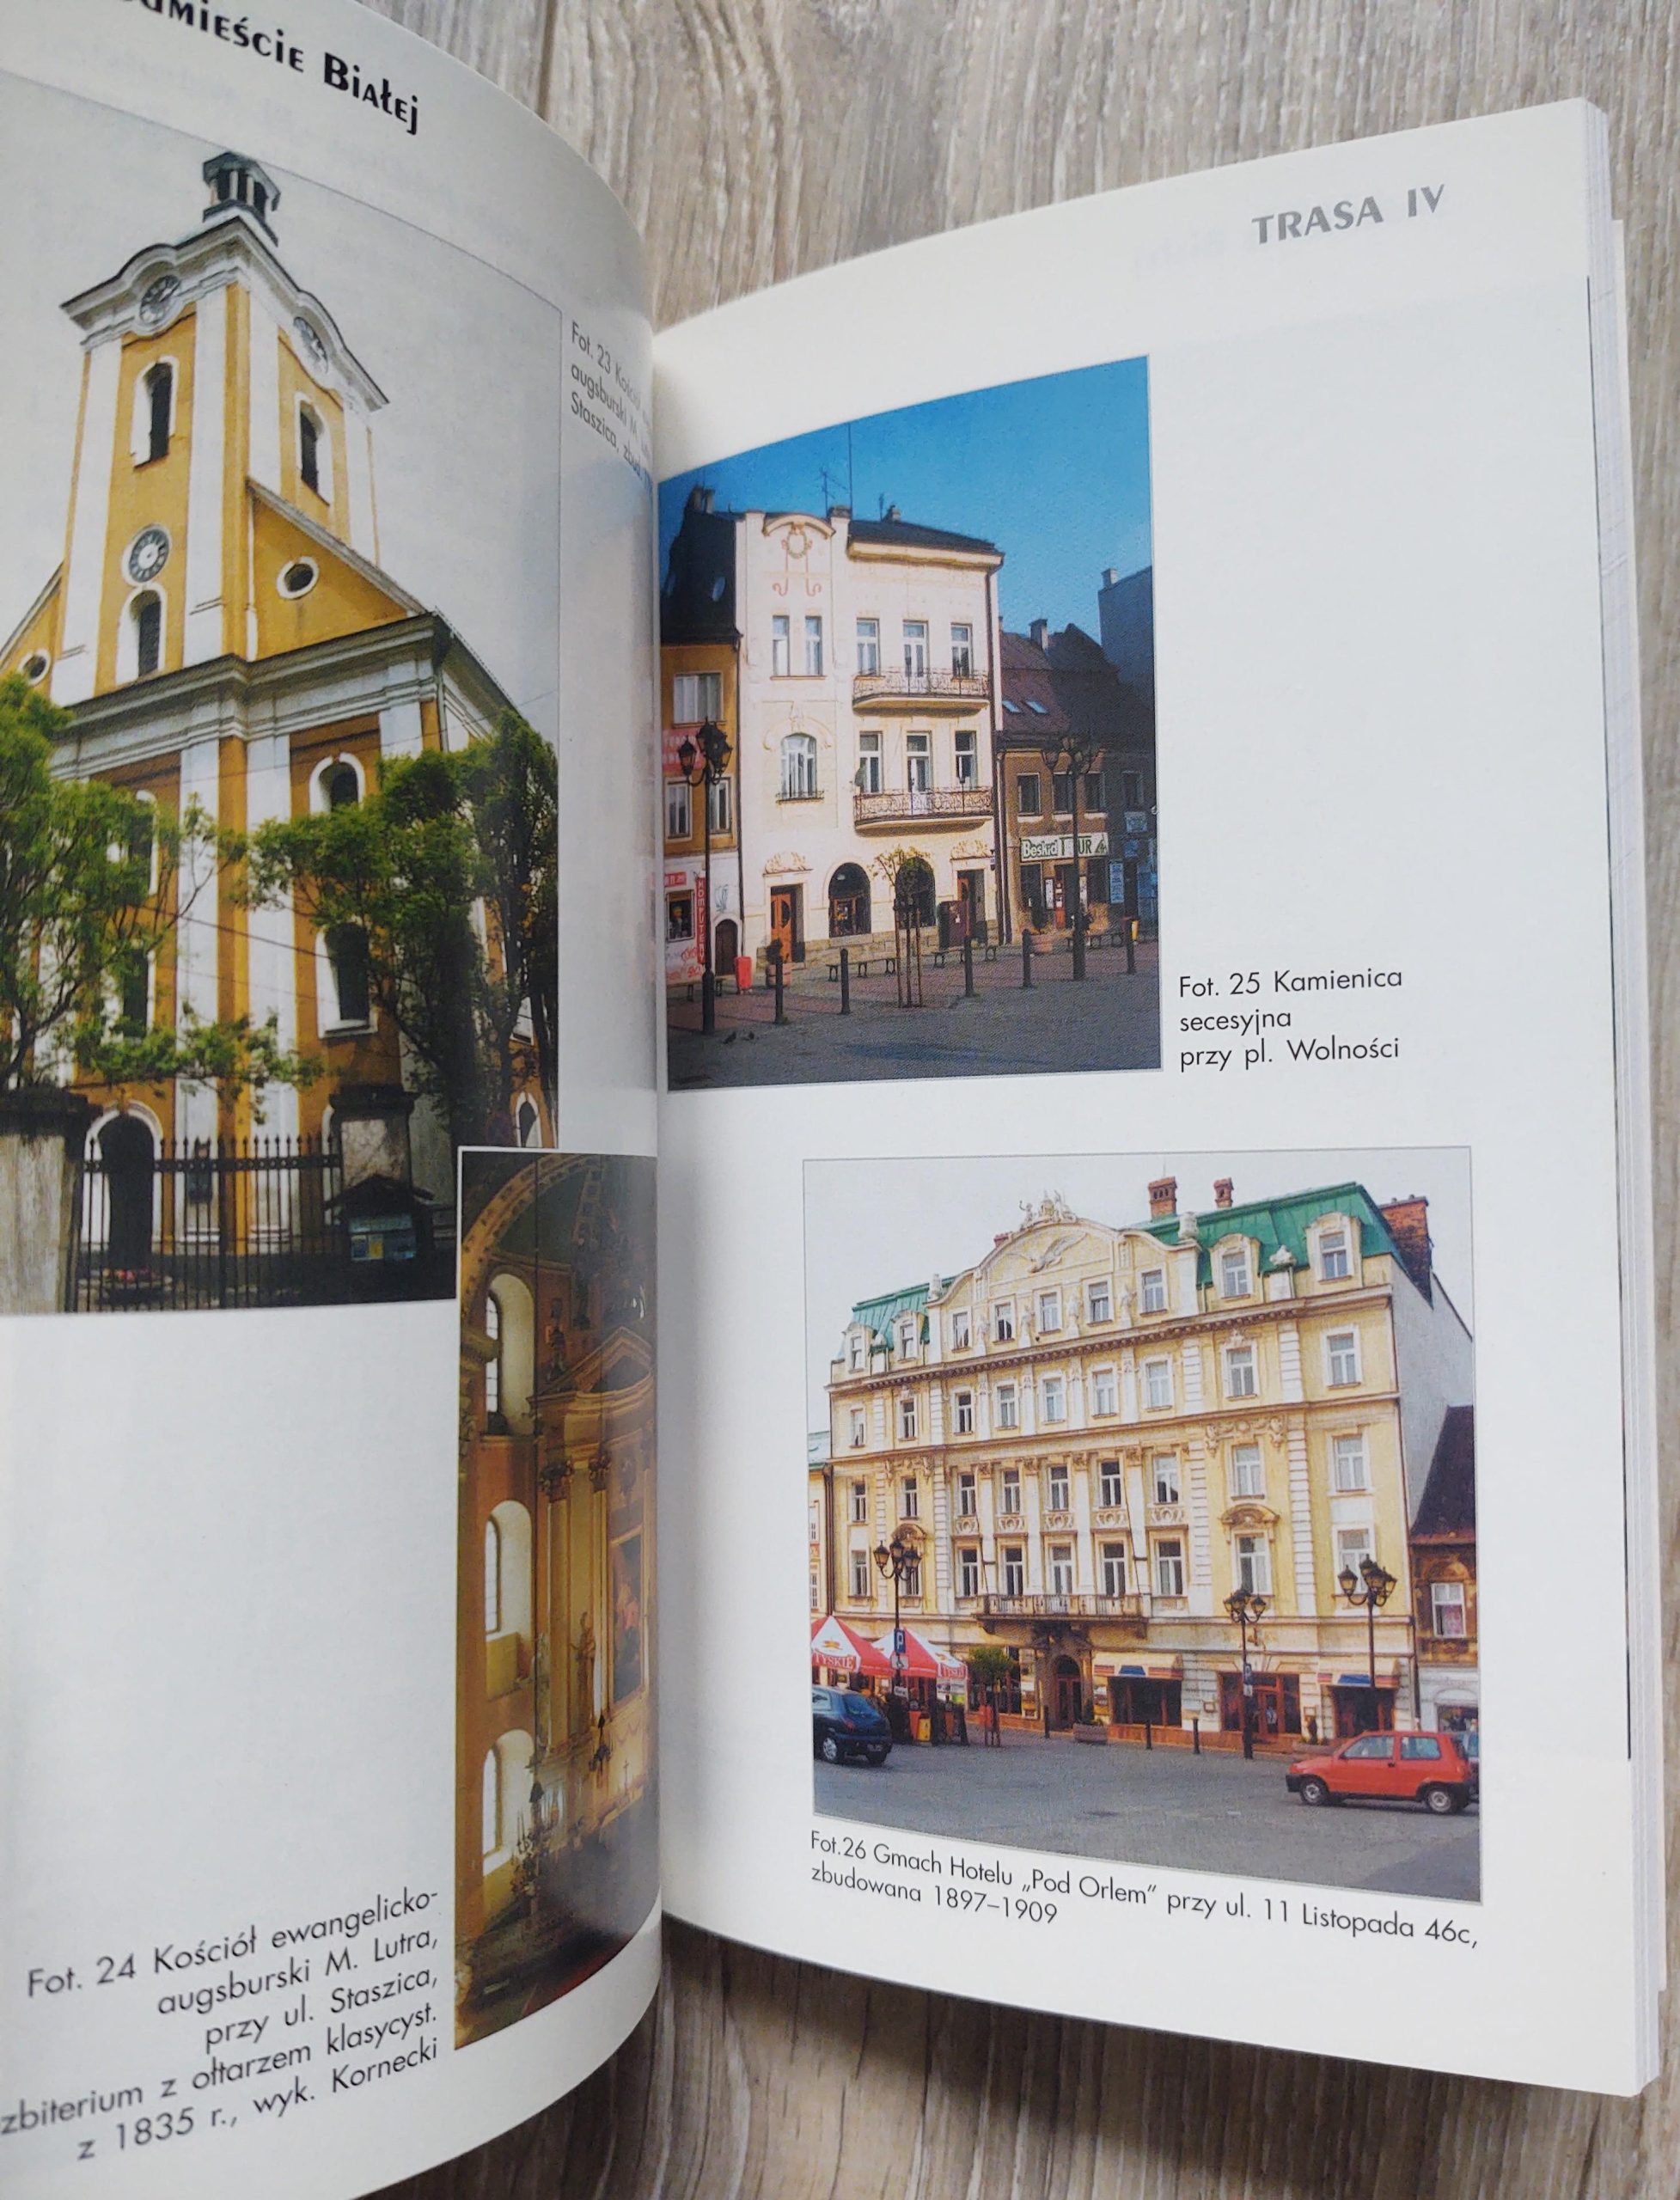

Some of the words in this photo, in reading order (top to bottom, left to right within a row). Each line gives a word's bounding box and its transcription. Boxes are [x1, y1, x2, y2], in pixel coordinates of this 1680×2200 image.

[1251, 196, 1384, 245] TRASA
[1408, 184, 1445, 217] IV
[571, 320, 593, 359] Fot.
[597, 343, 611, 375] 23
[571, 364, 626, 427] augsburski
[571, 391, 620, 453] Staszica,
[1022, 839, 1059, 859] Beskid
[1059, 835, 1093, 856] TUR
[1180, 975, 1219, 998] Fot.
[1229, 972, 1261, 995] 25
[1274, 968, 1402, 993] Kamienica
[1180, 1009, 1292, 1036] secesyjna
[1181, 1049, 1232, 1072] przy
[1245, 1037, 1273, 1070] pl.
[1286, 1034, 1400, 1061] Wolności
[815, 1651, 854, 1669] TYSKIE
[811, 1861, 921, 1902] zbudowana
[811, 1830, 866, 1859] Fot.26
[873, 1843, 942, 1874] Gmach
[950, 1856, 1013, 1885] Hotelu
[1022, 1868, 1070, 1893] „Pod
[1167, 1893, 1216, 1919] przy
[1226, 1892, 1251, 1917] ul.
[1264, 1898, 1288, 1922] 11
[1303, 1903, 1414, 1938] Listopada
[1425, 1919, 1478, 1949] 46c,
[27, 1967, 82, 1998] Fot.
[96, 1953, 136, 1986] 24
[154, 1924, 256, 1974] Kościół
[272, 1886, 437, 1949] ewangelicko-
[158, 1956, 309, 2014] augsburski
[325, 1946, 357, 1977] M.
[375, 1930, 437, 1962] Lutra,
[205, 2014, 269, 2055] przy
[284, 1994, 314, 2026] ul.
[330, 1969, 437, 2014] Staszica,
[0, 2086, 143, 2136] zbiterium
[161, 2078, 177, 2099] z
[192, 2044, 311, 2090] ołtarzem
[327, 2002, 436, 2055] klasycyst.
[77, 2139, 95, 2160] z
[117, 2106, 194, 2150] 1835
[211, 2107, 237, 2129] r.,
[253, 2075, 315, 2118] wyk.
[333, 2035, 437, 2093] Kornecki
